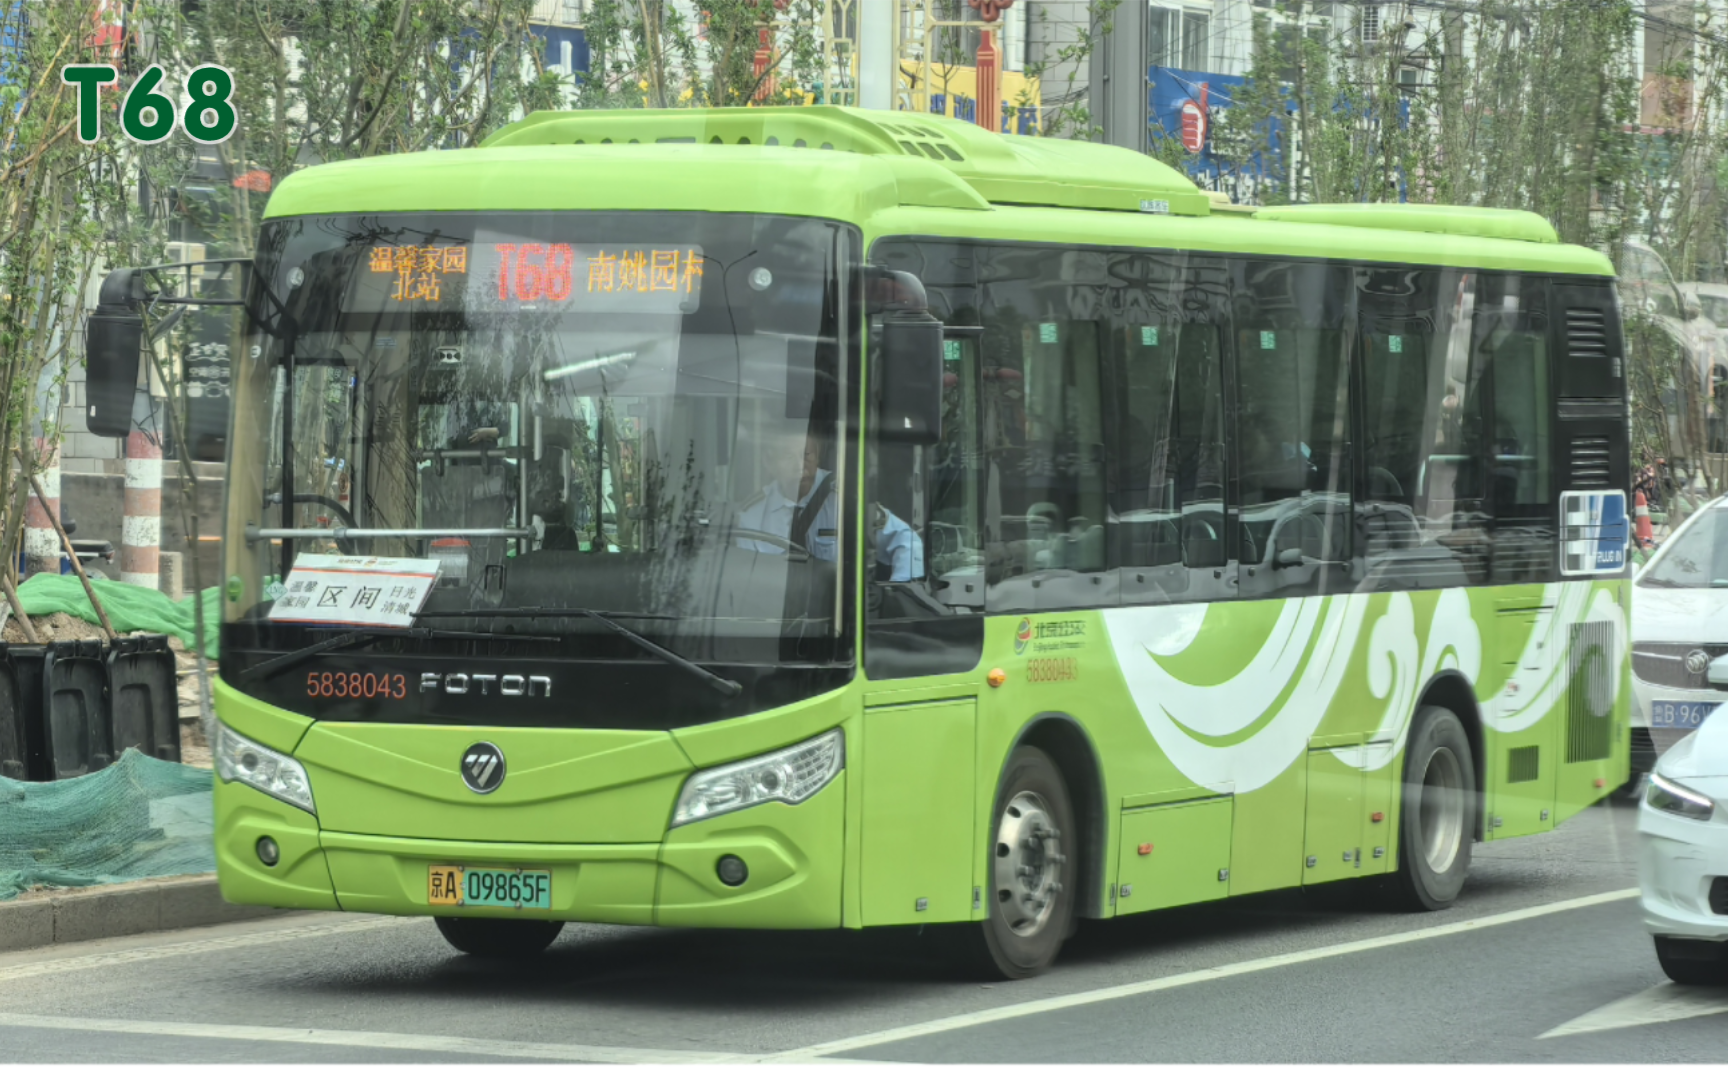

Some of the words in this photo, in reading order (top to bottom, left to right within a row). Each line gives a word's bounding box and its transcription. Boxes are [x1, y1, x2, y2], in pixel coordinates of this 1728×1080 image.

[369, 246, 467, 274] 温馨家园
[495, 243, 573, 301] T68
[391, 272, 442, 301] 北站
[290, 580, 318, 593] 温馨
[317, 585, 382, 610] 区间
[390, 586, 417, 599] 日光
[306, 672, 406, 698] 5838043
[420, 672, 551, 697] FOTON
